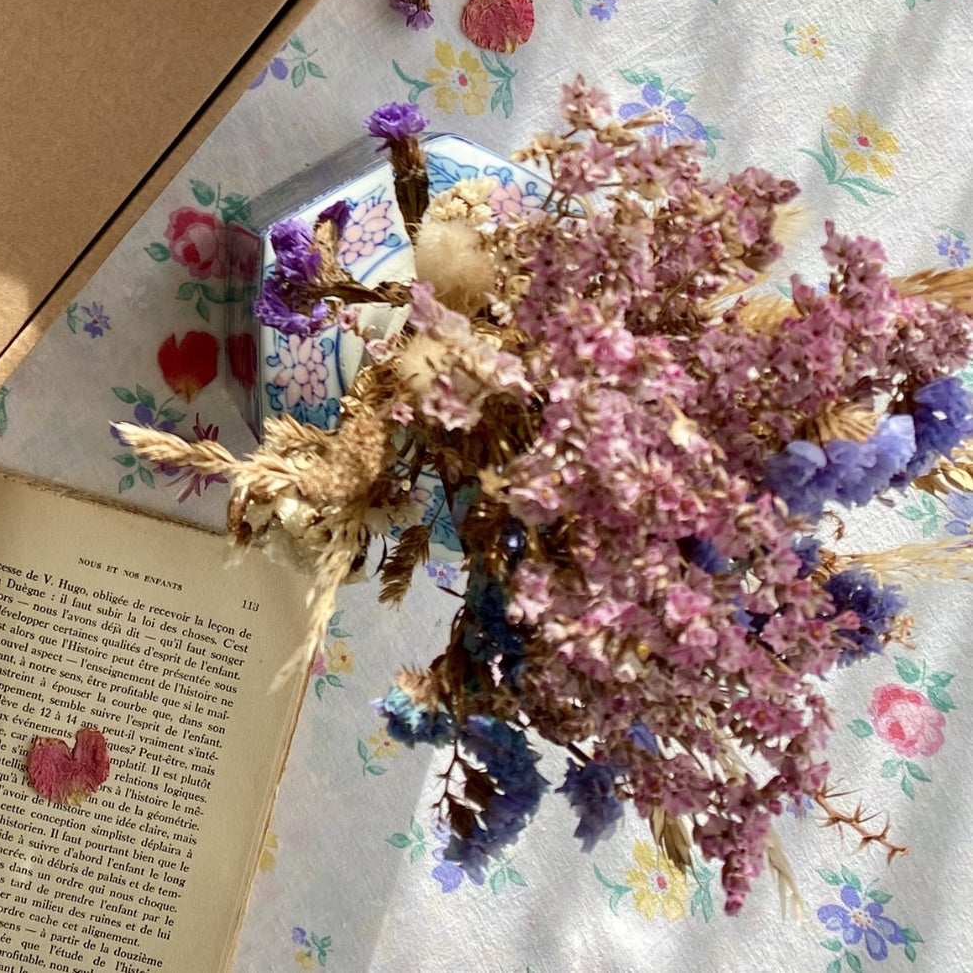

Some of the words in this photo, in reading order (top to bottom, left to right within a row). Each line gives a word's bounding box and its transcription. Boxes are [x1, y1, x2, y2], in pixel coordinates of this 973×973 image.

[77, 557, 102, 569] NOUS
[105, 564, 119, 574] ET
[122, 569, 140, 579] NOS
[143, 574, 183, 591] ENFANTS
[241, 599, 260, 612] 113
[52, 624, 98, 642] certaines
[101, 637, 141, 653] qualités
[143, 645, 181, 664] d'esprit
[184, 656, 197, 668] de
[200, 660, 240, 680] l'enfant.
[18, 656, 26, 667] à
[28, 661, 57, 675] notre
[58, 670, 83, 684] sens,
[86, 674, 107, 689] être
[109, 683, 159, 702] profitable
[161, 697, 180, 708] que
[182, 700, 192, 711] si
[194, 702, 204, 714] le
[206, 708, 230, 720] maî-
[49, 697, 86, 713] semble
[89, 707, 121, 722] suivre
[125, 714, 160, 732] l'esprit
[164, 725, 178, 737] de
[182, 728, 222, 749] l'enfant.
[0, 802, 26, 815] cette
[30, 811, 86, 831] conception
[90, 824, 136, 844] simpliste
[140, 837, 181, 856] déplaira
[185, 848, 193, 859] à
[8, 861, 33, 877] dans
[37, 871, 51, 881] un
[55, 876, 84, 889] ordre
[88, 884, 106, 895] qui
[108, 890, 134, 902] nous
[137, 895, 177, 913] choque.
[17, 834, 24, 845] à
[27, 839, 60, 854] suivre
[63, 847, 103, 865] d'abord
[106, 857, 145, 876] l'enfant
[149, 867, 159, 880] le
[163, 871, 186, 888] long
[28, 913, 59, 927] cache
[61, 921, 78, 931] cet
[81, 924, 140, 947] alignement.
